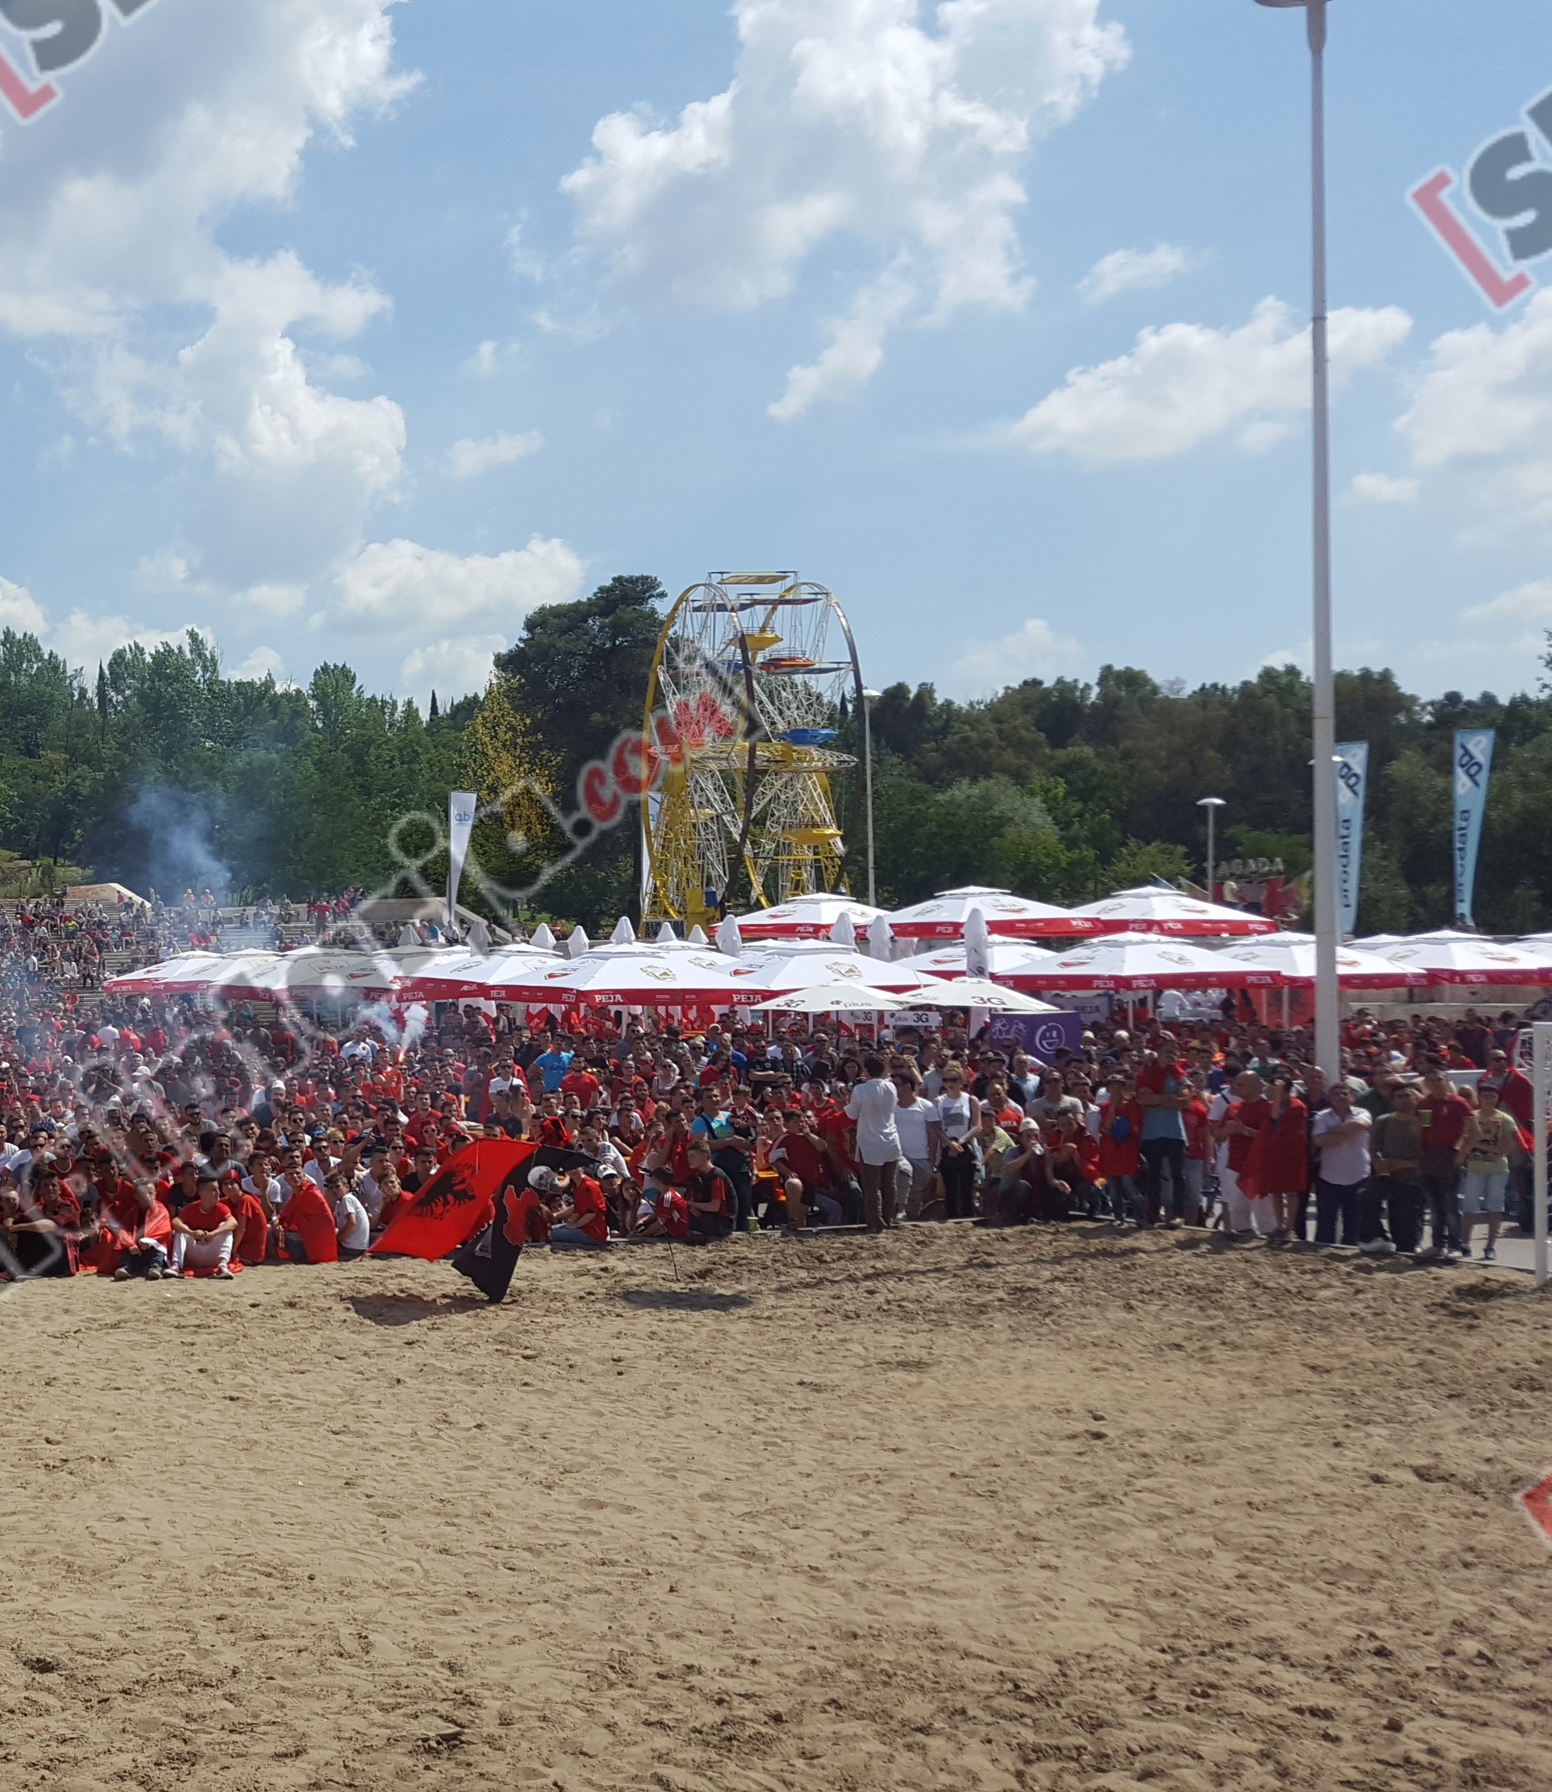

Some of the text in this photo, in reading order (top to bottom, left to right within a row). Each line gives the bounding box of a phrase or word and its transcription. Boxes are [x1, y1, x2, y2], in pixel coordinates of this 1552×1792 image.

[775, 999, 803, 1009] 3G
[970, 995, 1007, 1006] 3G
[913, 1012, 930, 1023] 3G
